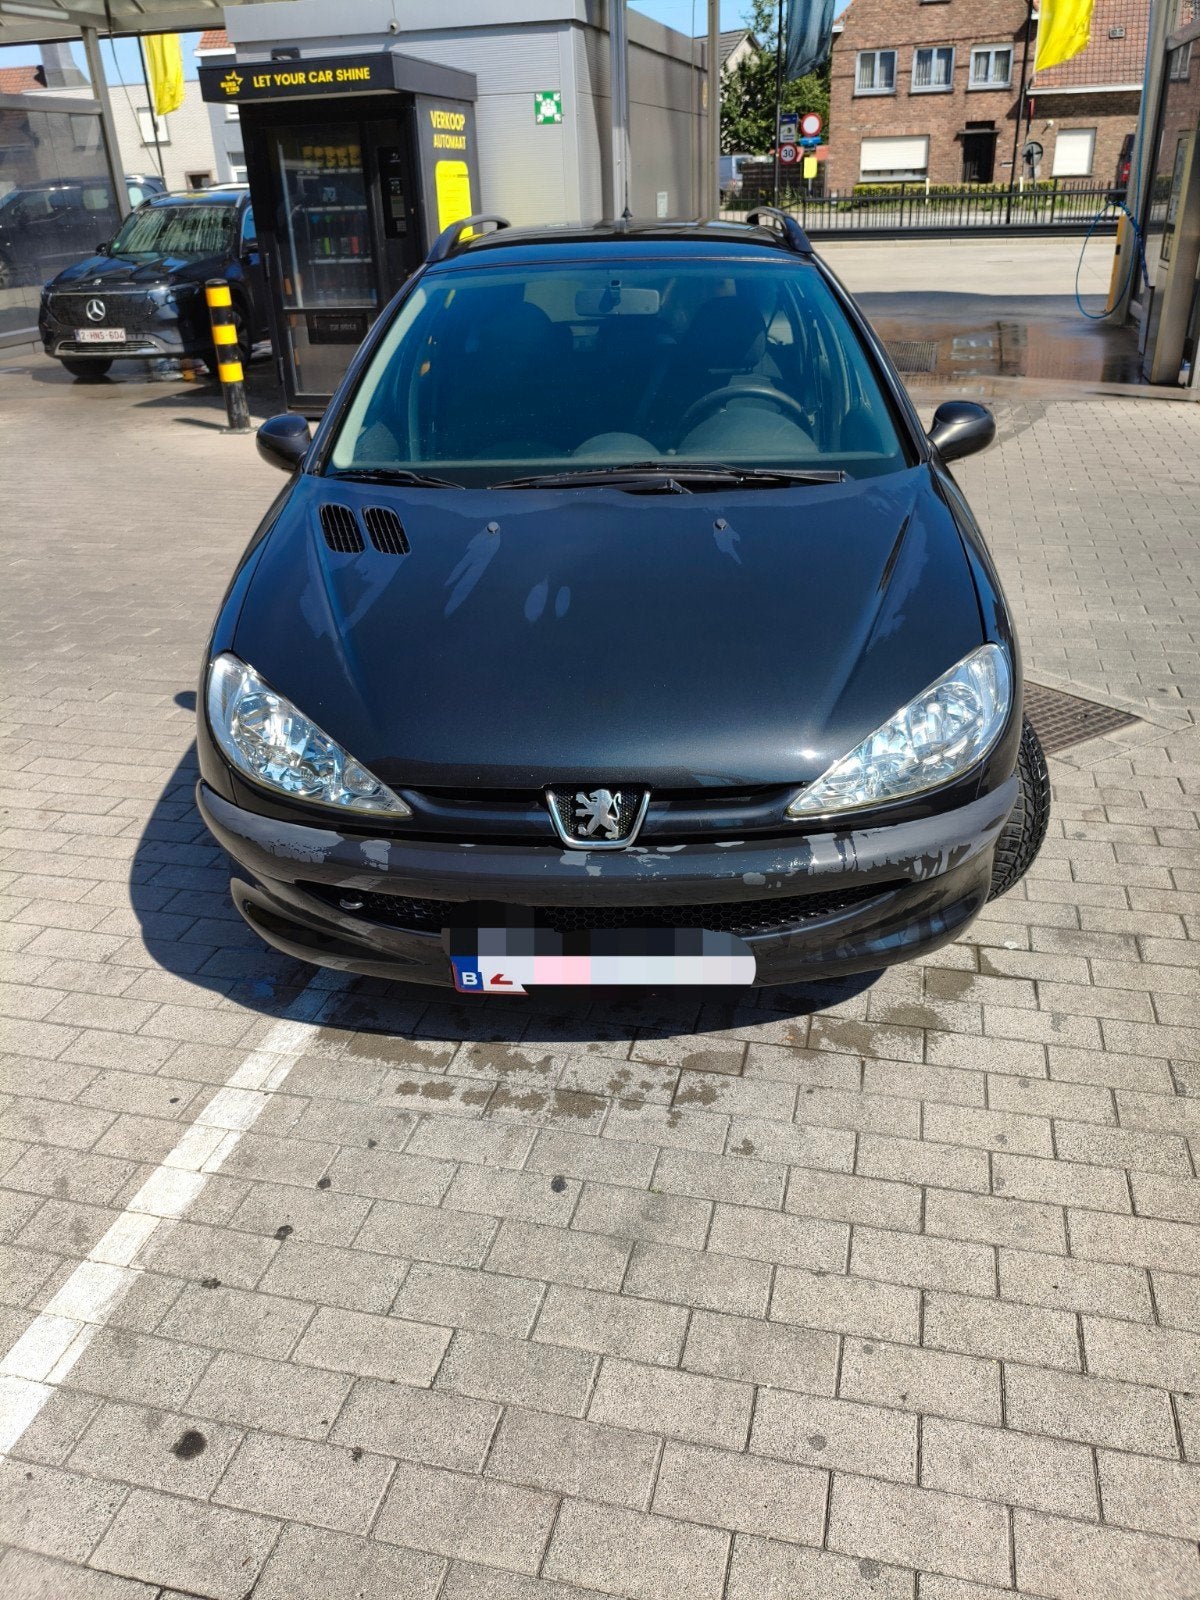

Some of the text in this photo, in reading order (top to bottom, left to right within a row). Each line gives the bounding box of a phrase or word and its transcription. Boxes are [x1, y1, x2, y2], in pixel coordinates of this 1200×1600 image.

[252, 74, 272, 88] LET
[274, 72, 307, 86] YOUR
[308, 70, 334, 84] CAR
[336, 66, 370, 82] SHINE
[430, 110, 465, 132] VERKOOP
[433, 133, 466, 151] AUTOMAAT
[783, 149, 794, 158] 30
[461, 971, 478, 986] B
